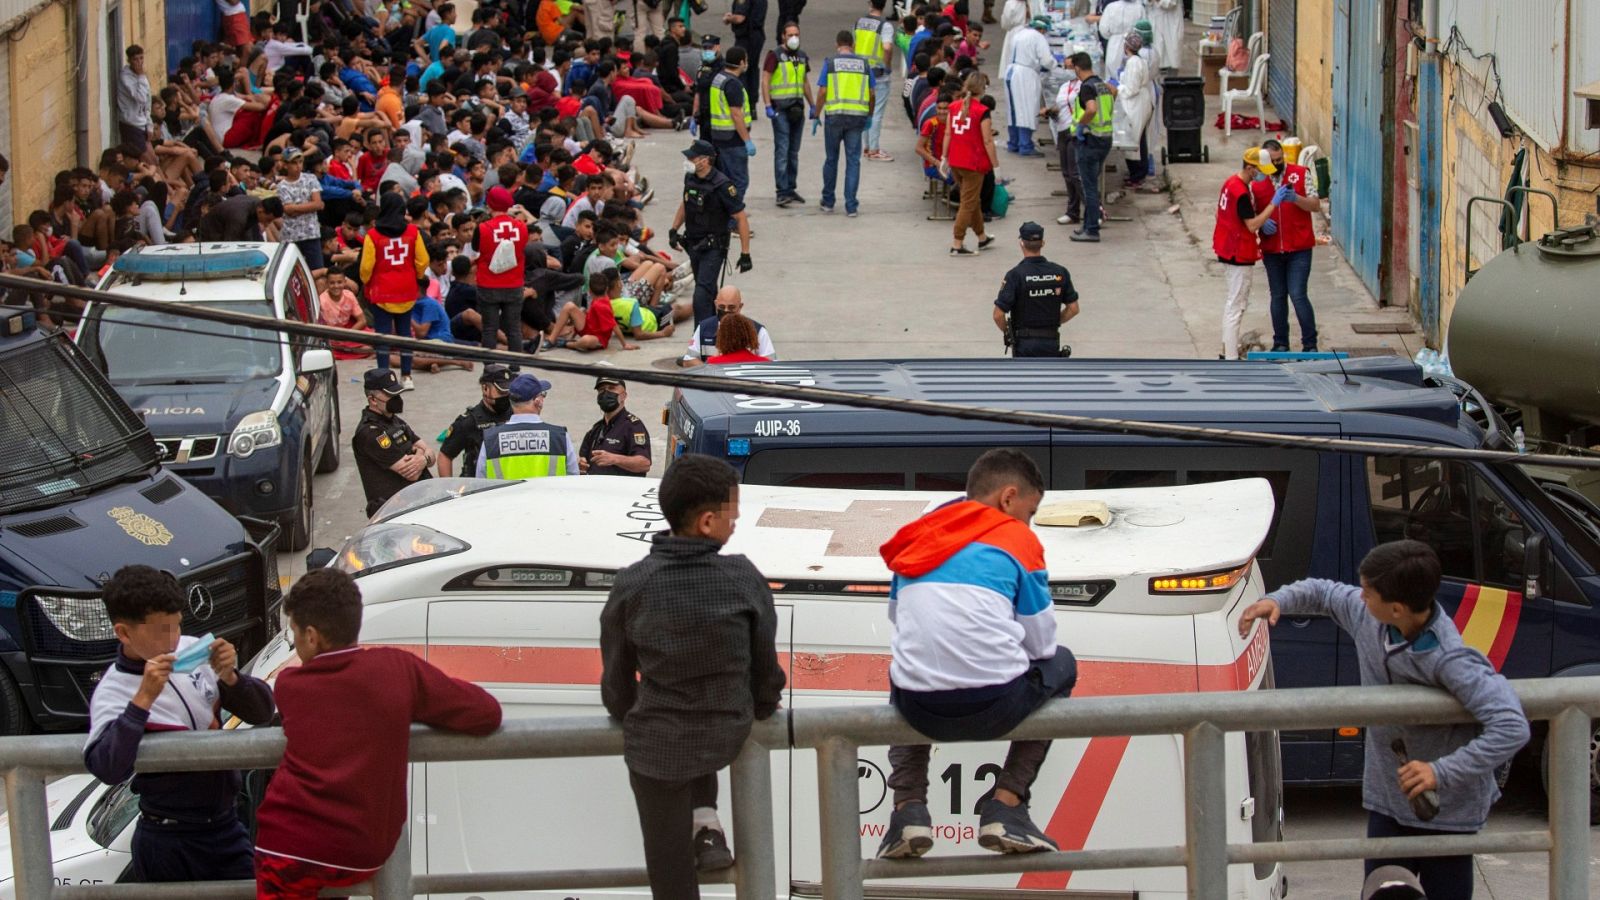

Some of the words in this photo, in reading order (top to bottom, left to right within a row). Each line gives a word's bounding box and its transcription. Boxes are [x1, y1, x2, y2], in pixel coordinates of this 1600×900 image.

[136, 407, 206, 416] OLICIA
[754, 419, 801, 437] 4UIP-36
[501, 439, 548, 452] POLICIA
